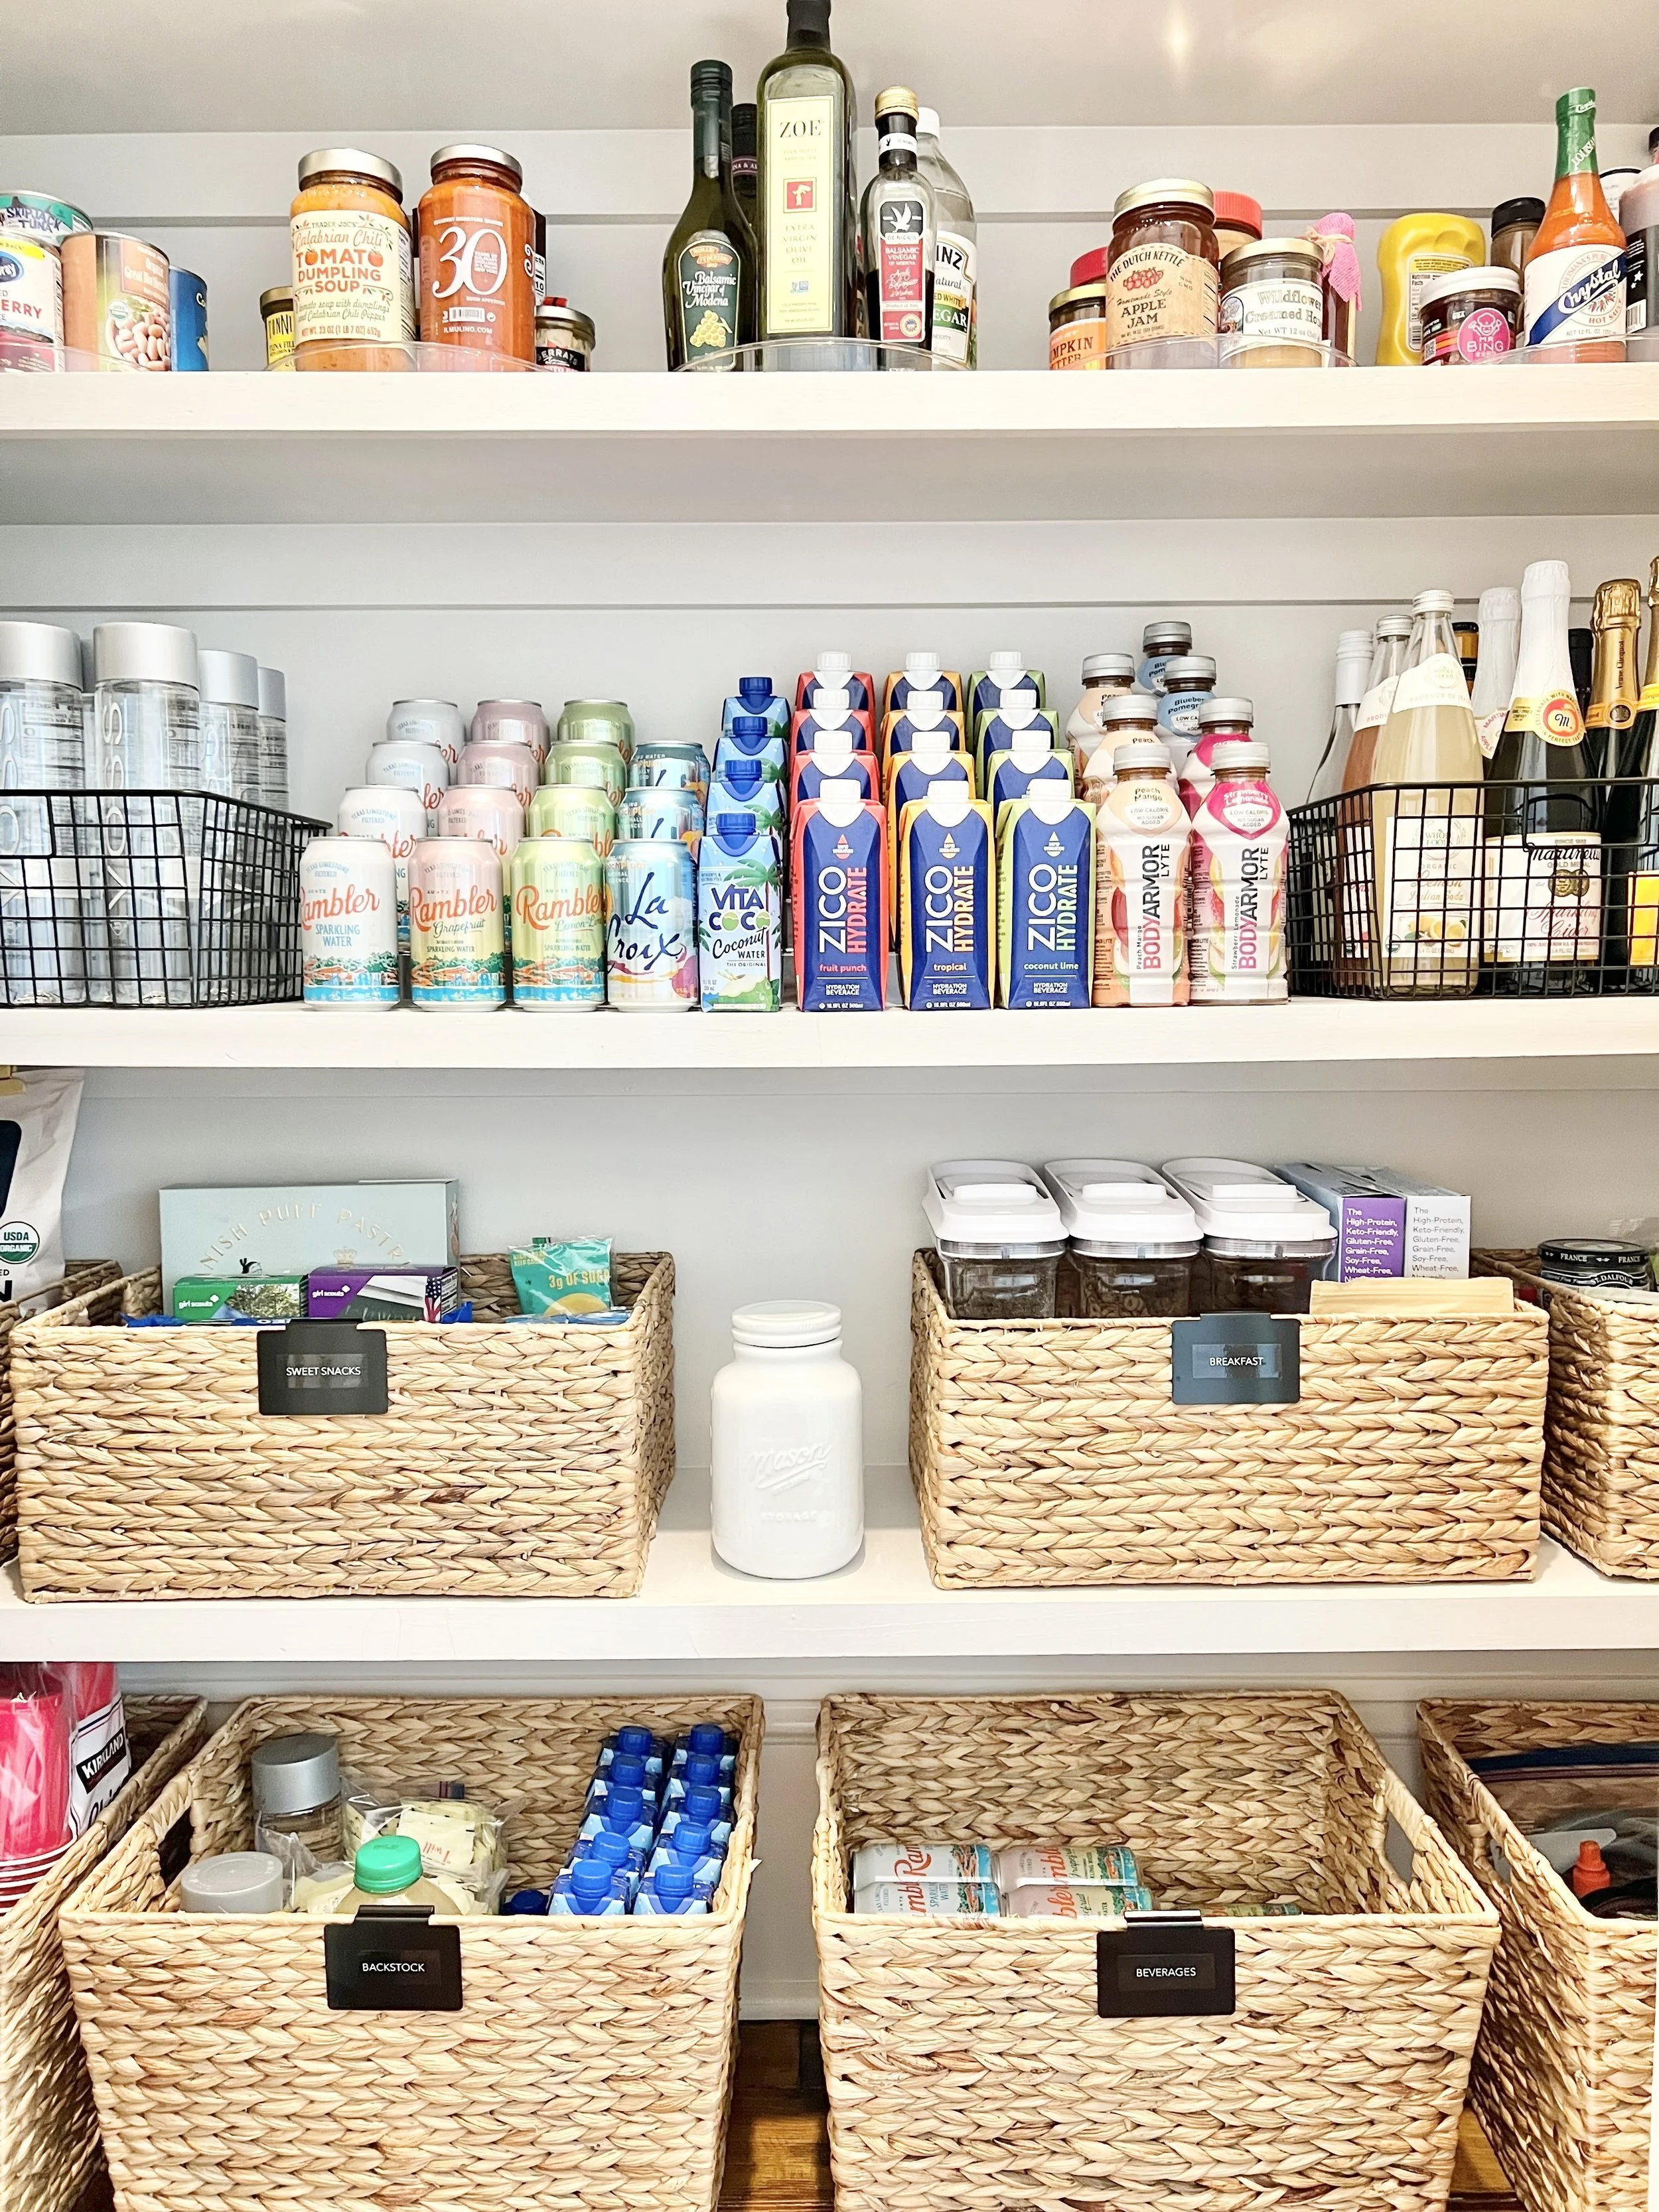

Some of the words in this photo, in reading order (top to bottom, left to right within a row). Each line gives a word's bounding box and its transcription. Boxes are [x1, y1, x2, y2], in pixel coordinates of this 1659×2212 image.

[780, 119, 821, 138] ZOE
[19, 219, 53, 233] TUNA
[295, 229, 349, 252] Calabrian
[353, 229, 383, 248] Chili
[296, 248, 384, 268] TOMATO
[885, 246, 920, 255] BALSAMIC
[936, 245, 962, 270] INZ
[432, 226, 508, 299] 30
[1110, 265, 1122, 282] THE
[1122, 251, 1151, 269] DUTCH
[1153, 250, 1185, 268] KETTLE
[299, 267, 382, 283] DUMPLING
[694, 271, 737, 285] Balsamic
[936, 276, 962, 289] atural
[1179, 275, 1193, 285] Non
[315, 280, 361, 293] SOUP
[682, 281, 719, 297] Vinegar
[1179, 281, 1194, 291] GMO
[1557, 259, 1621, 314] Crystal
[685, 293, 729, 309] Modena
[943, 295, 962, 307] WHITE
[1117, 291, 1151, 306] Homemade
[1153, 289, 1173, 299] Style
[1257, 289, 1322, 312] Wildflower
[319, 300, 334, 311] soup
[335, 298, 352, 309] with
[352, 299, 390, 314] dumplings
[1121, 299, 1167, 318] APPLE
[307, 309, 341, 323] Calabrian
[342, 308, 360, 320] Chili
[360, 309, 386, 323] Pepper
[934, 309, 968, 327] EGAR
[1127, 313, 1159, 329] JAM
[1245, 308, 1303, 325] Creamed
[1616, 640, 1625, 669] Clicquot
[1174, 698, 1205, 706] Blueber
[1409, 693, 1445, 703] PRODUCT
[1168, 703, 1200, 715] Pomegr
[1480, 735, 1494, 751] APPLE
[1548, 734, 1572, 744] PERFECT
[1223, 790, 1269, 800] Strawberry
[1161, 844, 1170, 877] LYTE
[1260, 846, 1269, 880] LYTE
[625, 871, 669, 929] La
[711, 883, 764, 910] VITA
[409, 885, 498, 932] Rambler
[818, 865, 847, 954] ZICO
[846, 866, 867, 954] HYDRATE
[924, 865, 954, 954] ZICO
[953, 865, 974, 953] HYDRATE
[1028, 863, 1058, 952] ZICO
[1056, 864, 1078, 951] HYDRATE
[1142, 844, 1161, 970] BODYARMOR
[1238, 847, 1260, 970] BODYARMOR
[315, 923, 360, 935] SPARKLING
[433, 918, 486, 938] Grapefruit
[708, 911, 771, 932] COCO
[323, 936, 352, 947] WATER
[712, 926, 766, 959] Coconut
[820, 964, 839, 972] fruit
[839, 964, 867, 973] punch
[933, 962, 968, 973] tropical
[1060, 962, 1080, 970] lime
[1346, 1218, 1398, 1227] High-Protein,
[1413, 1217, 1464, 1225] High-Protein,
[4, 1232, 29, 1240] USDA
[200, 1222, 248, 1270] NISH
[259, 1203, 323, 1226] PUFF
[1345, 1228, 1399, 1237] Keto-Friendly,
[1413, 1226, 1465, 1234] Keto-Friendly,
[1344, 1256, 1382, 1265] Soy-Free,
[1560, 1252, 1588, 1262] FRANCE
[548, 1274, 563, 1290] 3g
[566, 1272, 581, 1286] OF
[582, 1268, 611, 1285] SUGA
[1600, 1274, 1634, 1286] DALFOUR
[312, 1290, 324, 1299] girl
[179, 1299, 190, 1309] girl
[190, 1299, 213, 1308] scouts
[1208, 1356, 1264, 1367] BREAKFAST
[285, 1365, 320, 1376] SWEET
[321, 1365, 362, 1376] SNACKS
[750, 1441, 833, 1479] Mason
[760, 1511, 819, 1522] STORAGE
[81, 1733, 124, 1779] KIRKLAND
[362, 1962, 425, 1973] BACKSTOCK
[1135, 1966, 1196, 1978] BEVERAGES
